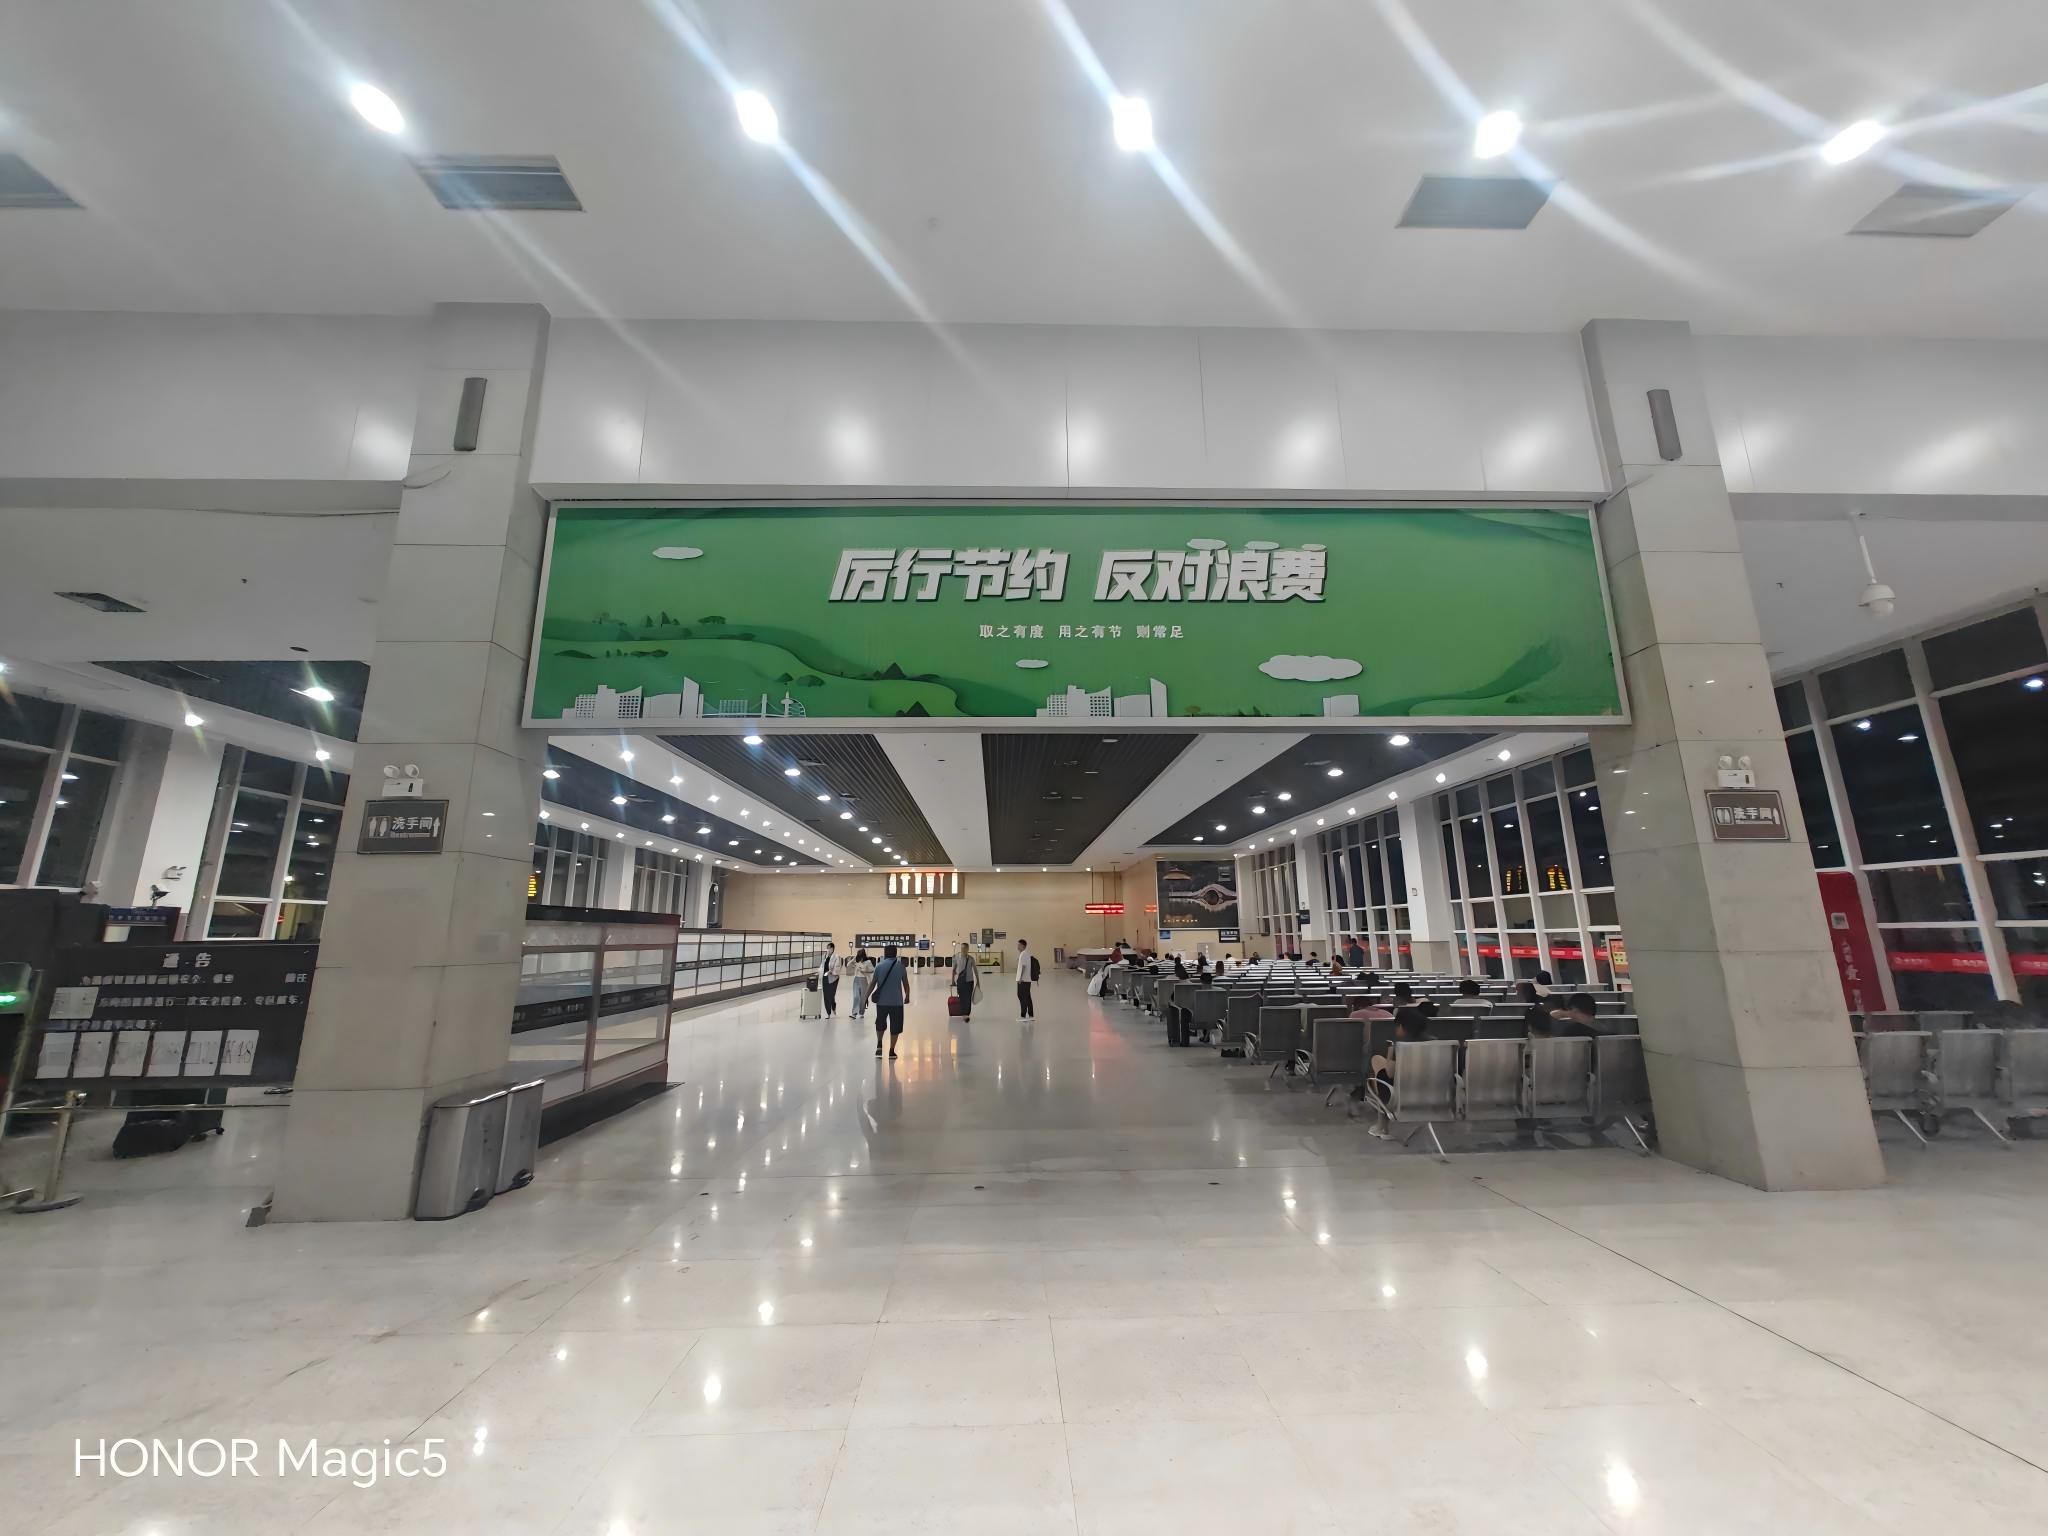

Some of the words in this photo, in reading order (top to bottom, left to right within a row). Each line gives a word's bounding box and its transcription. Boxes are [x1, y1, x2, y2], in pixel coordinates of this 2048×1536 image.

[829, 548, 1070, 602] 厉行节约
[1093, 548, 1328, 602] 反对浪费
[979, 624, 1045, 639] 取之有度
[1058, 624, 1123, 639] 用之有节
[1136, 624, 1184, 639] 则常足
